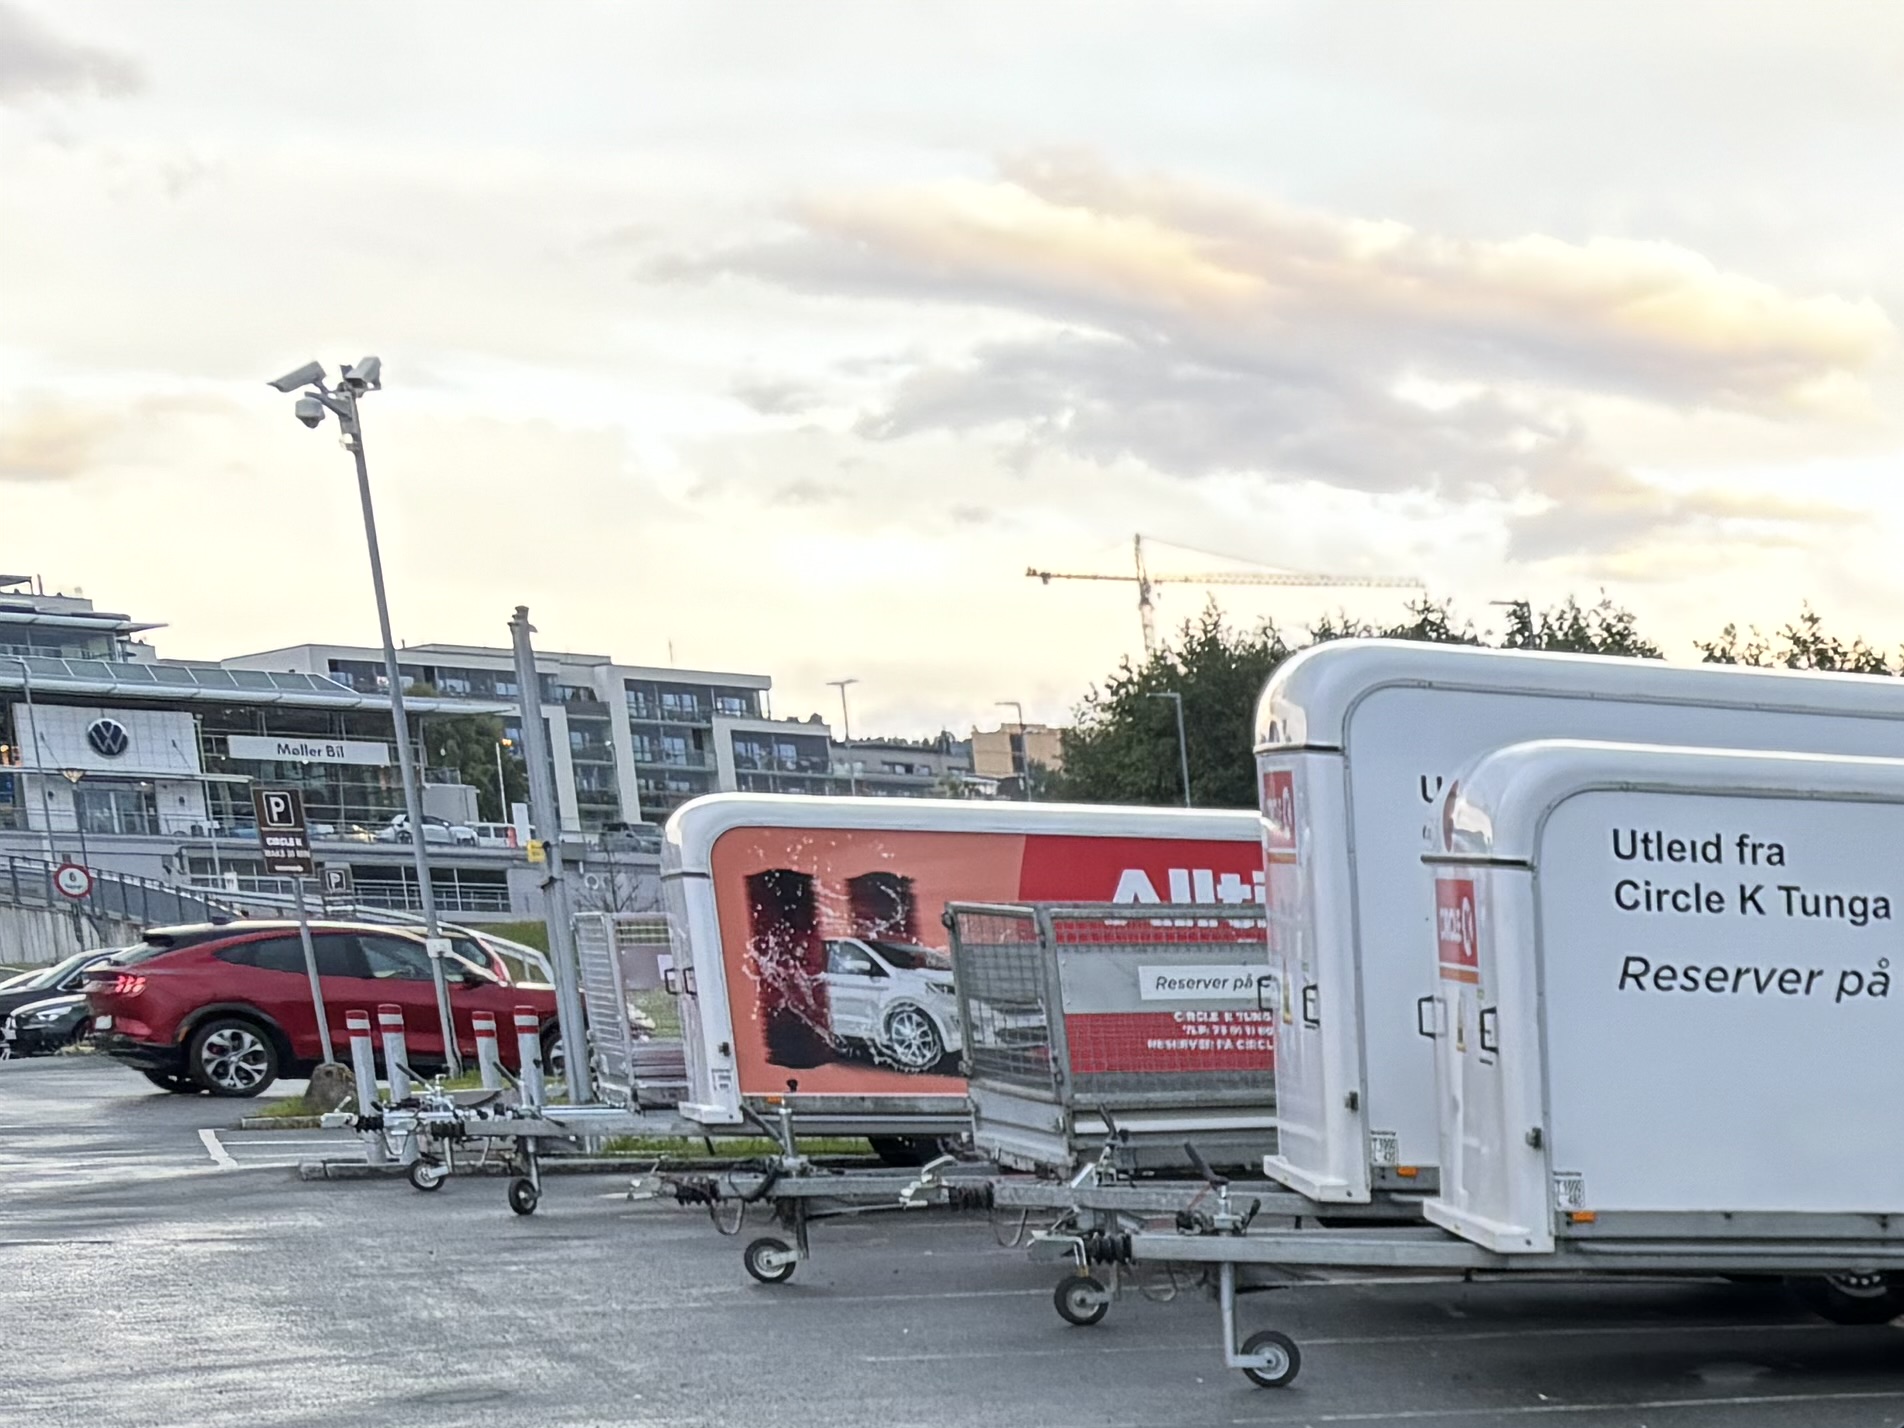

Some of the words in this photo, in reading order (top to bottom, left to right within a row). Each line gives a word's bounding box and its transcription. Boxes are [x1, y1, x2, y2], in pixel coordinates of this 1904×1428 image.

[326, 744, 345, 759] Bil
[1612, 828, 1723, 865] Utleid
[1735, 833, 1786, 867] fra
[1614, 879, 1726, 913] Circle
[1739, 883, 1767, 916] K
[1777, 884, 1892, 927] Tunga
[1156, 976, 1229, 991] Reserver
[1232, 973, 1254, 992] på
[1618, 955, 1825, 996] Reserver
[1835, 956, 1892, 1004] på
